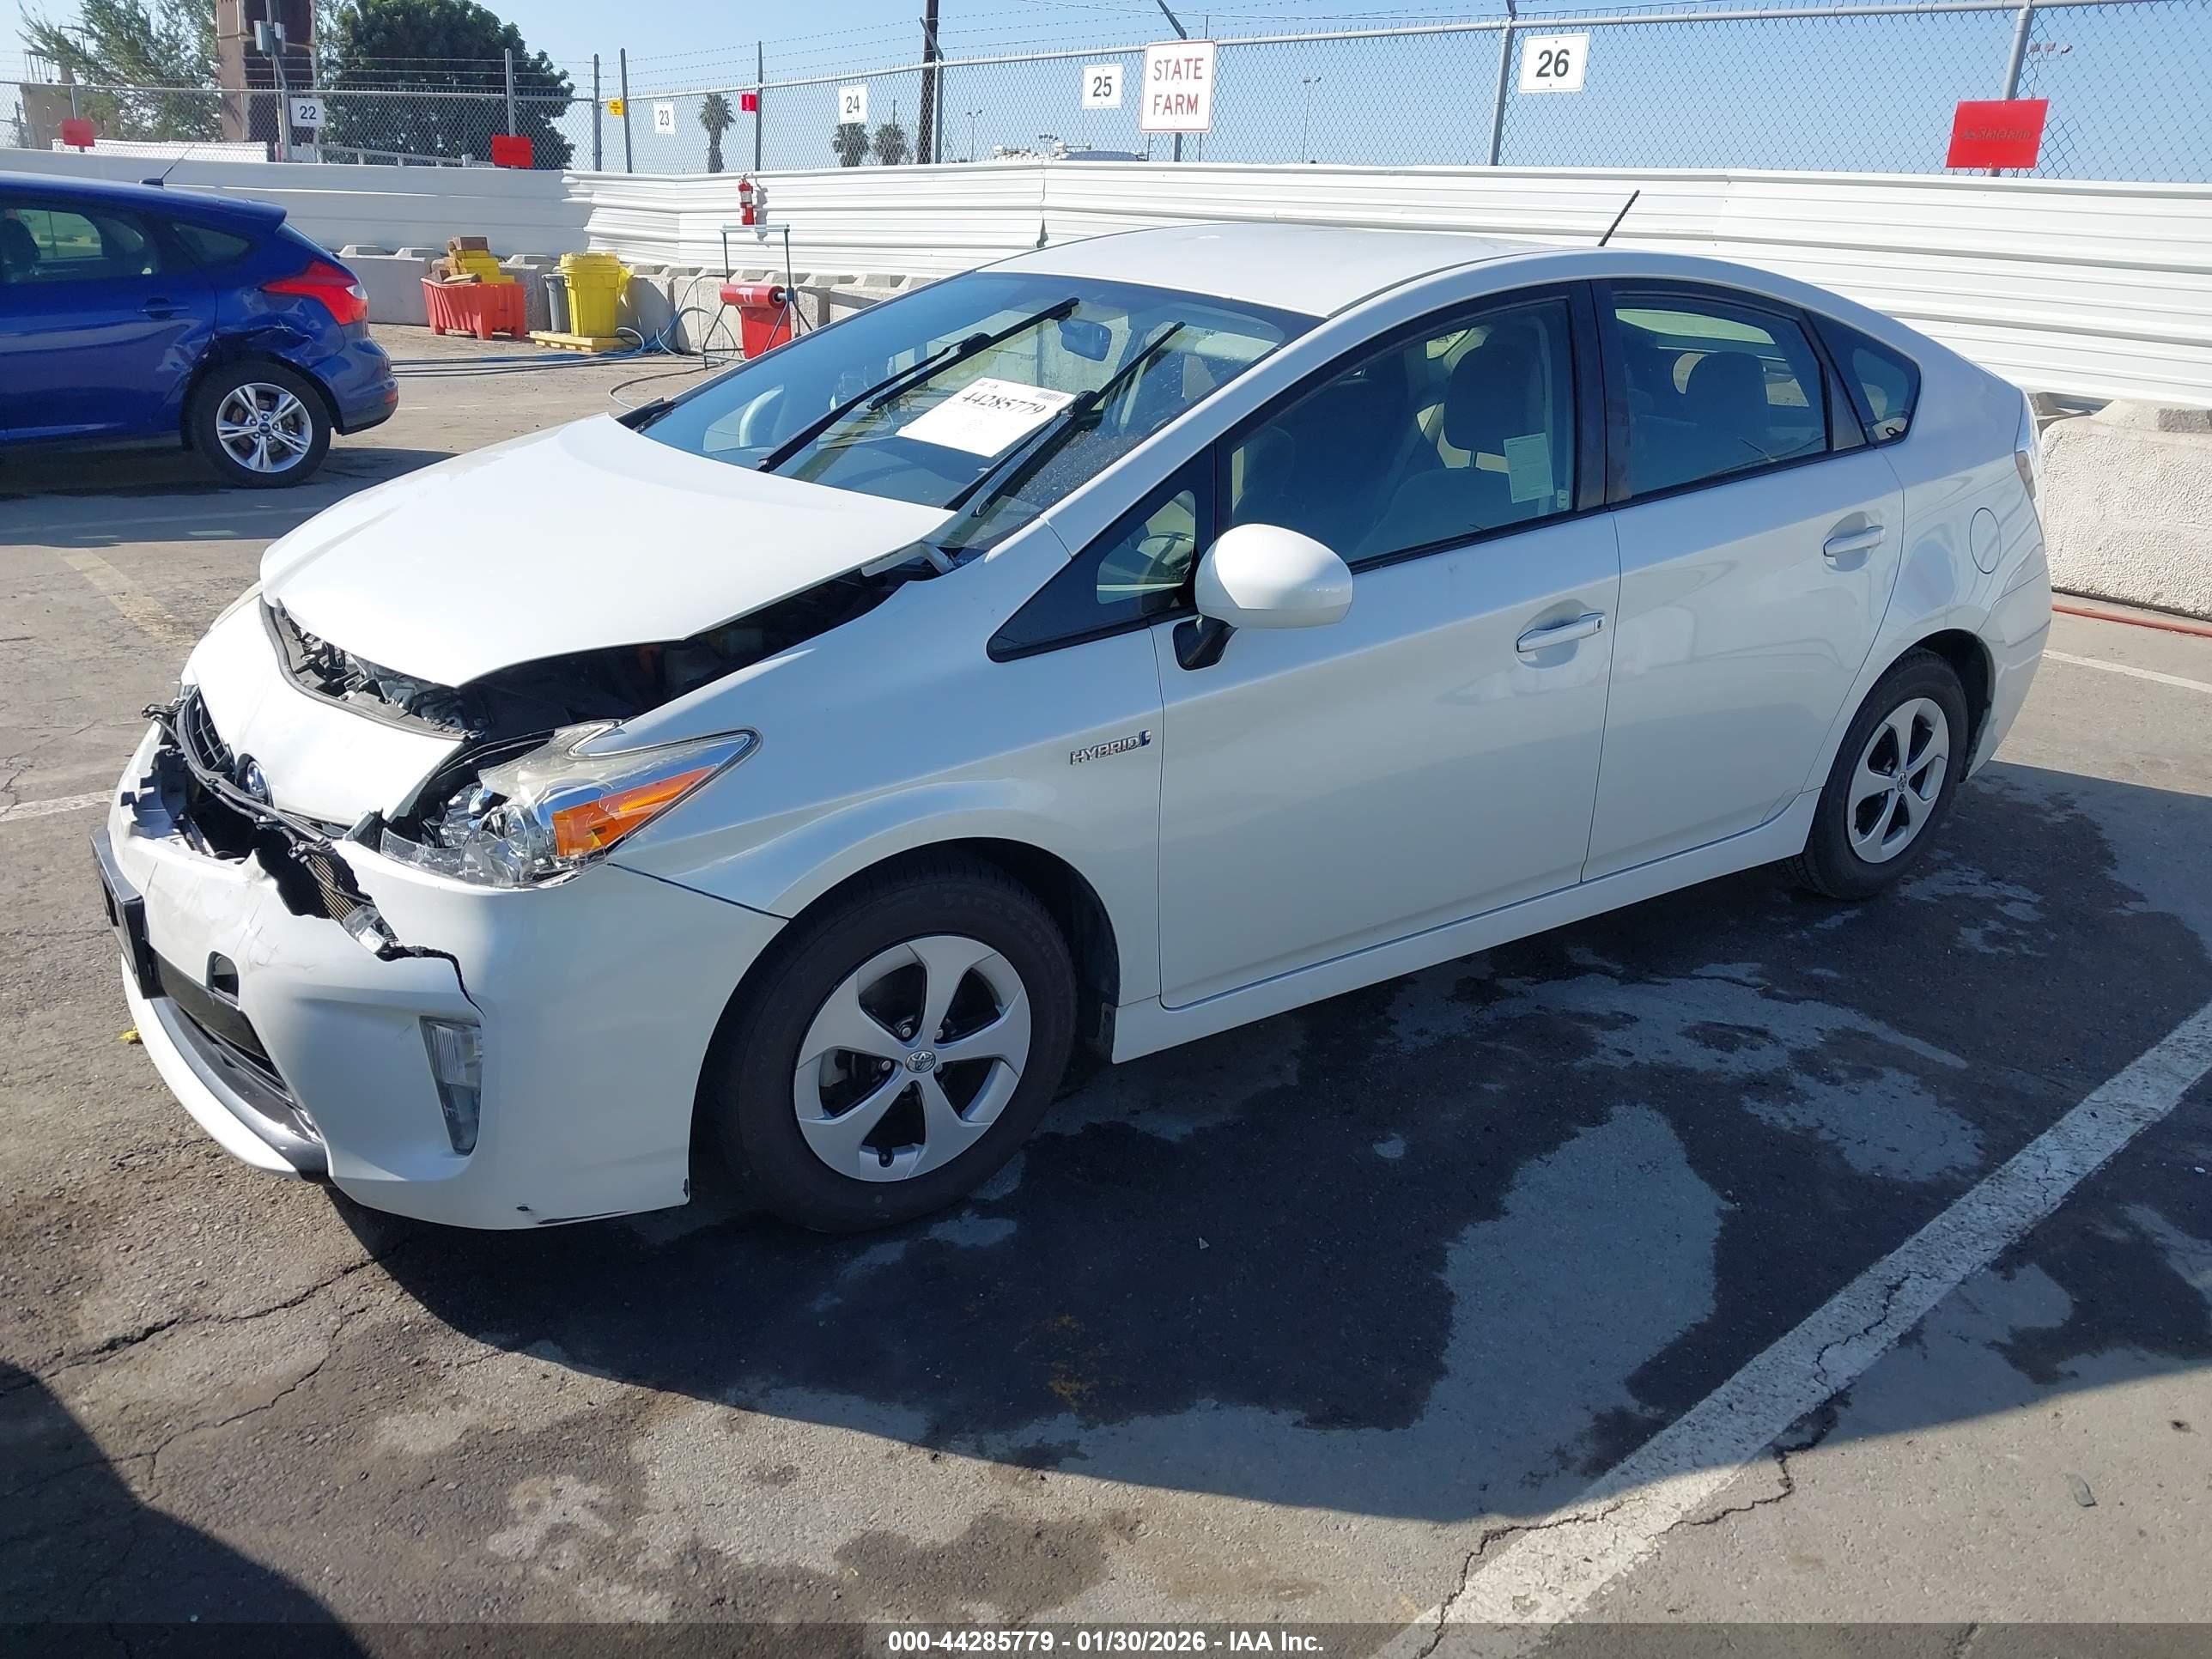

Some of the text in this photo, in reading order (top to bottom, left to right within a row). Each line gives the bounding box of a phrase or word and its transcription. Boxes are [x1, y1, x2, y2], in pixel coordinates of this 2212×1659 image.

[1153, 58, 1204, 82] STATE
[1535, 48, 1571, 78] 26
[1092, 76, 1113, 97] 25
[299, 105, 317, 120] 22
[846, 94, 860, 114] 24
[1153, 94, 1199, 116] FARM
[659, 109, 670, 125] 23
[962, 391, 1047, 415] 44285779
[1070, 736, 1140, 765] HYBRID
